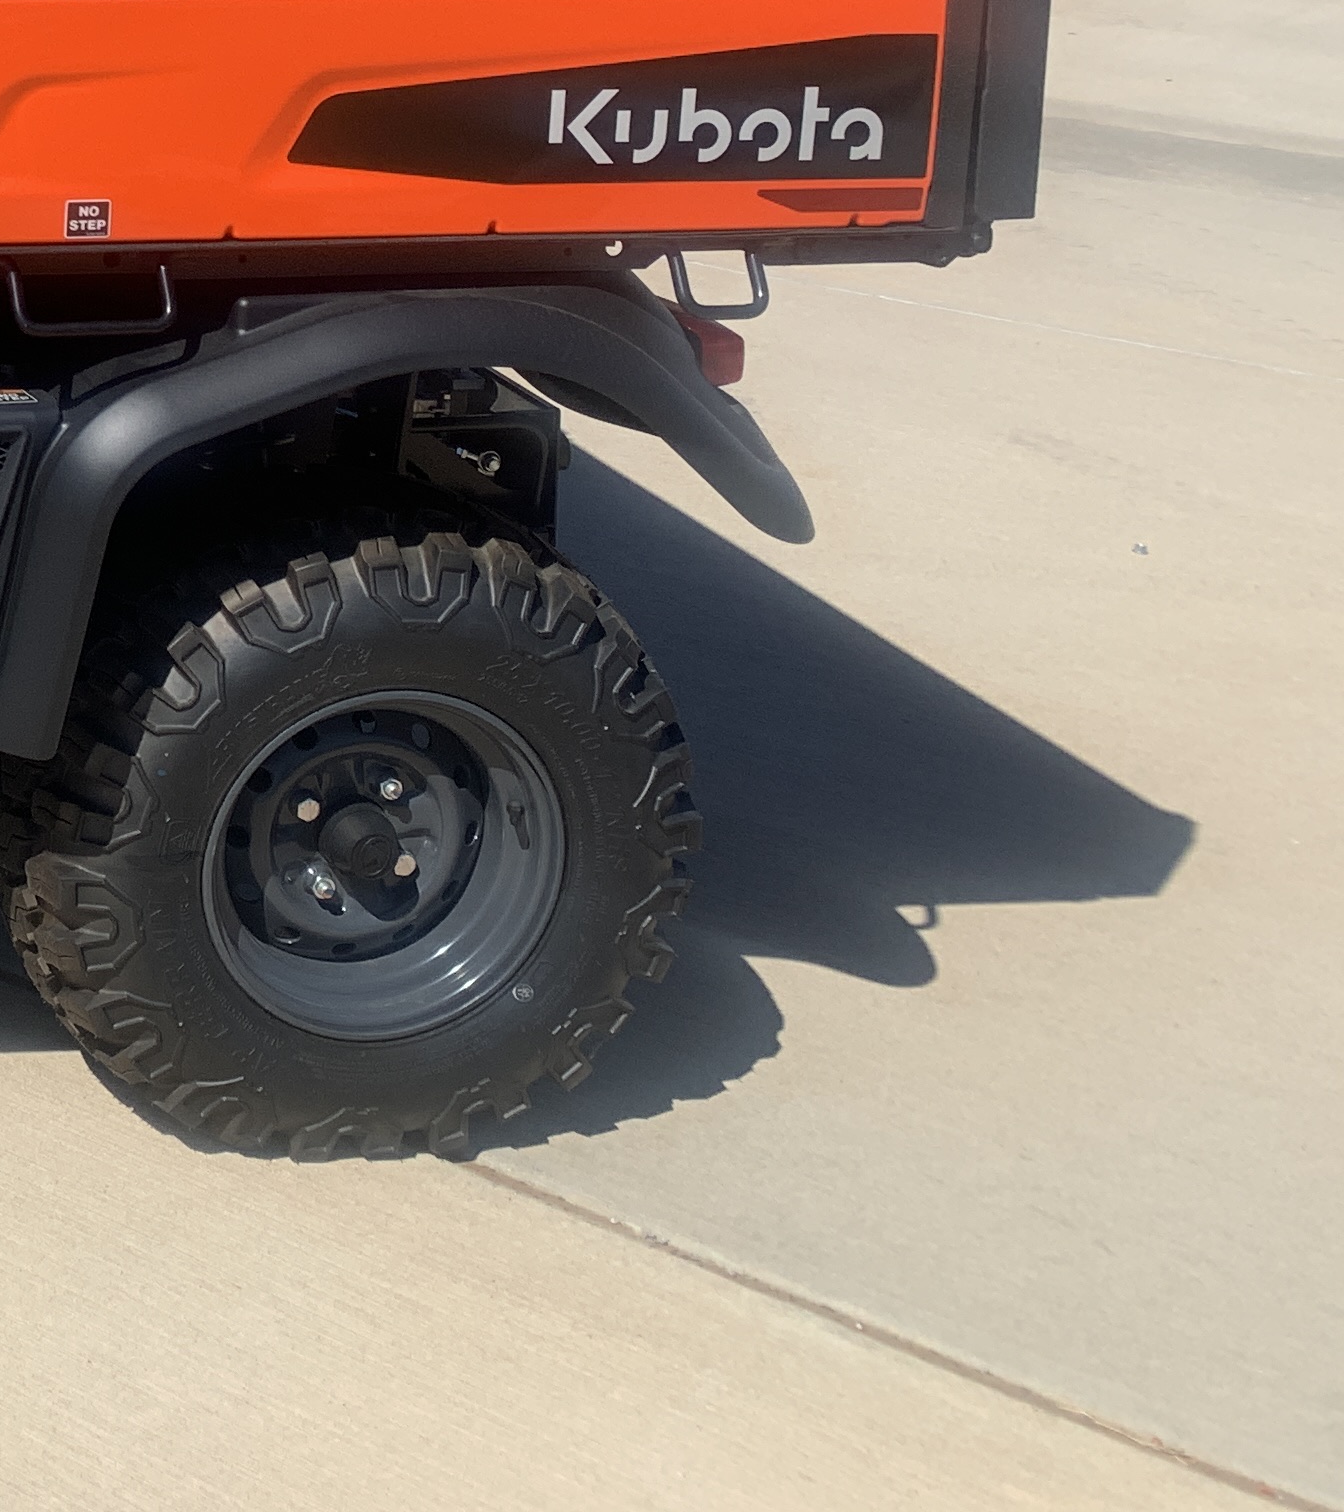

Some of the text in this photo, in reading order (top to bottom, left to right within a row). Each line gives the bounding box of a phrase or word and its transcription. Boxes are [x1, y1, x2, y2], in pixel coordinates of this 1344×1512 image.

[547, 86, 885, 165] Kubota
[78, 205, 100, 217] NO
[69, 219, 106, 231] STEP
